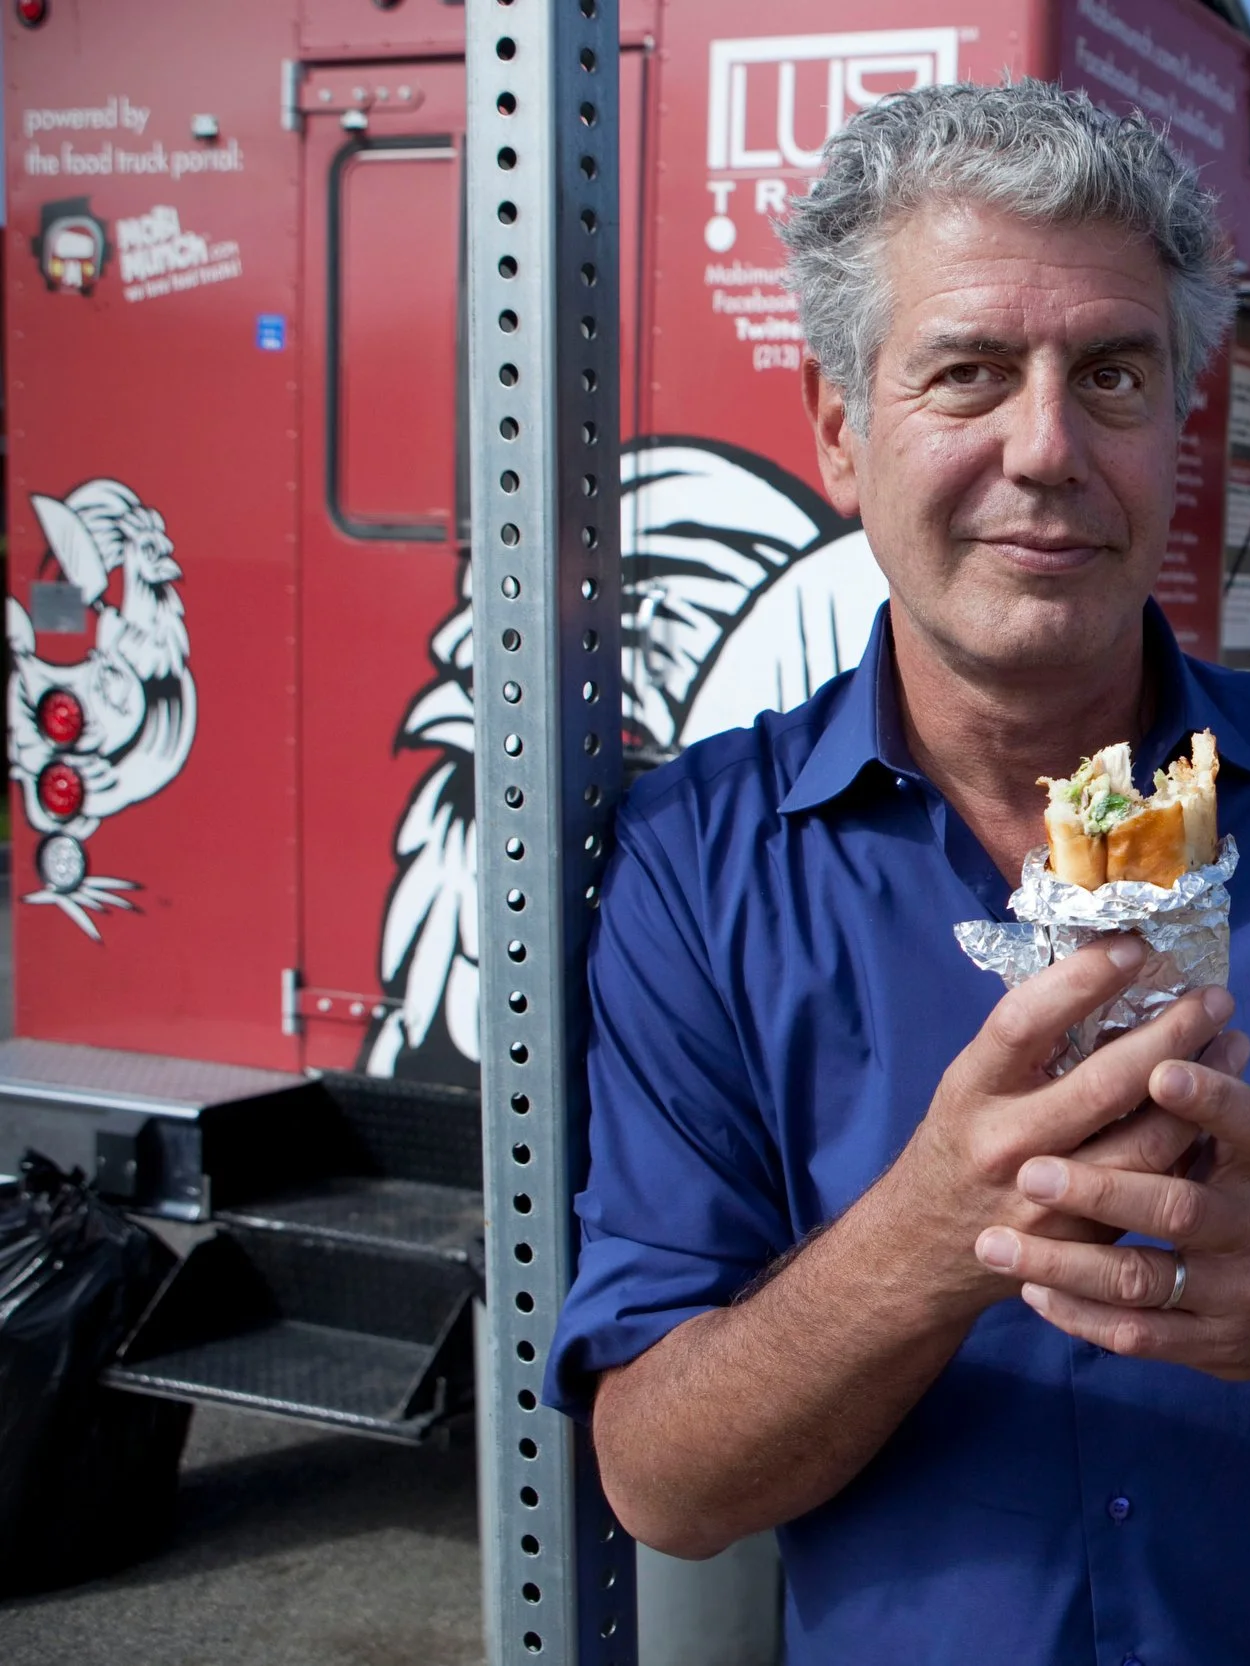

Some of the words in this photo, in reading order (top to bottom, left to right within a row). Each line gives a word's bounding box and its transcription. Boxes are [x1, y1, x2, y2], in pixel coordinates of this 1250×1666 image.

[24, 95, 118, 138] powered
[119, 95, 151, 135] by
[25, 141, 60, 176] the
[61, 141, 114, 176] food
[115, 140, 169, 173] truck
[735, 316, 804, 342] Twitte
